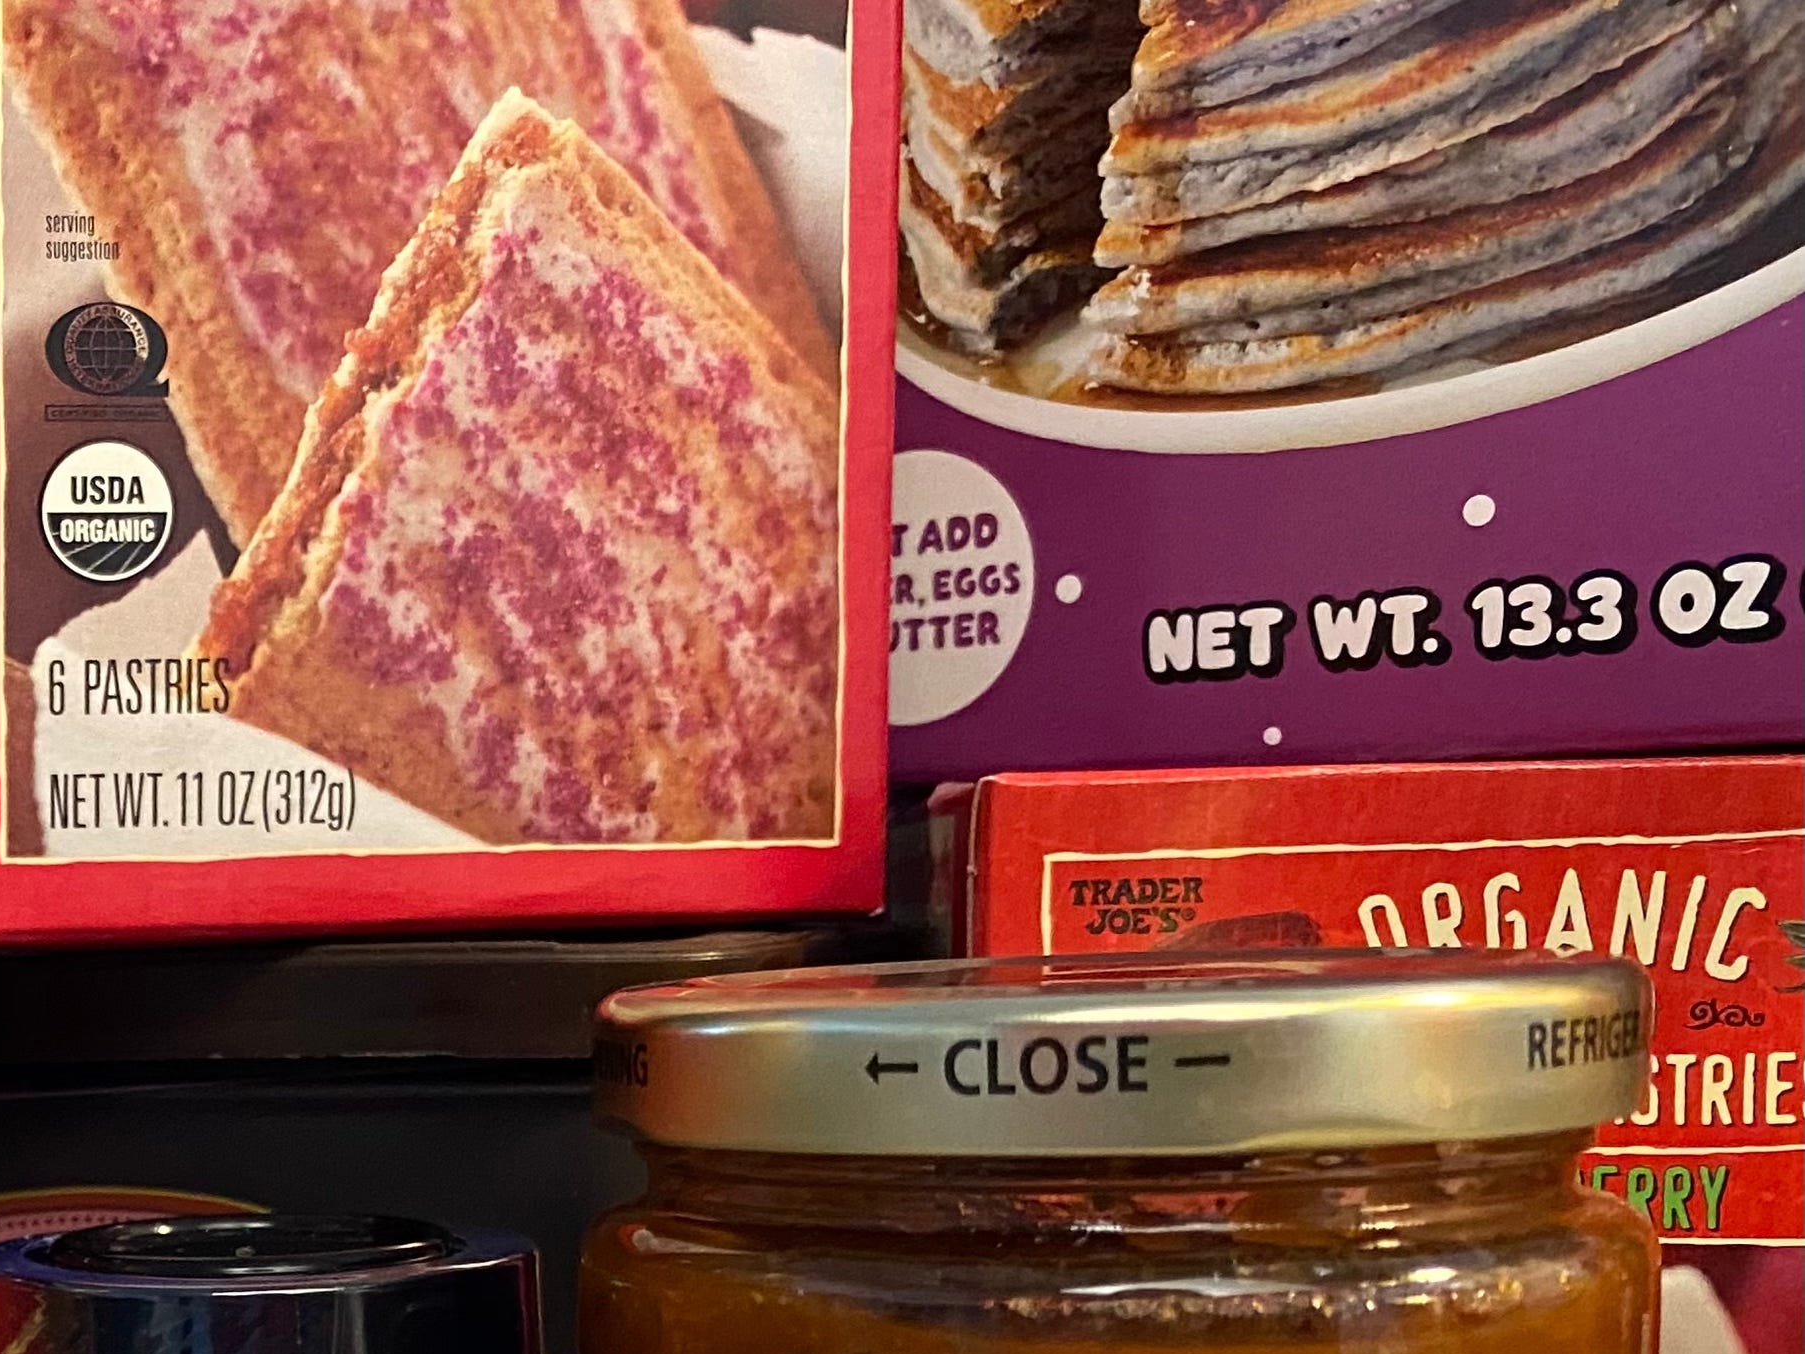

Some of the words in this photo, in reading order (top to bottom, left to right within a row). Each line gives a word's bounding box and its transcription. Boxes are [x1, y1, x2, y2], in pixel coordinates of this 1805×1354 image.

[46, 212, 95, 236] serving
[46, 239, 119, 262] suggestion
[70, 475, 145, 507] USDA
[60, 516, 156, 546] ORGANIC
[917, 513, 998, 555] ADD
[933, 562, 1020, 601] EGGS
[1147, 606, 1283, 674] NET
[1315, 595, 1439, 661] WT.
[1472, 579, 1623, 646] 13.3
[1659, 560, 1771, 636] OZ
[49, 656, 66, 718] 6
[84, 656, 231, 716] PASTRIES
[49, 775, 103, 831] NET
[112, 772, 169, 829] WT.
[178, 771, 207, 827] 11
[216, 771, 259, 826] OZ
[263, 766, 356, 832] (312g)
[1071, 877, 1203, 906] TRADER
[943, 1035, 1150, 1095] CLOSE
